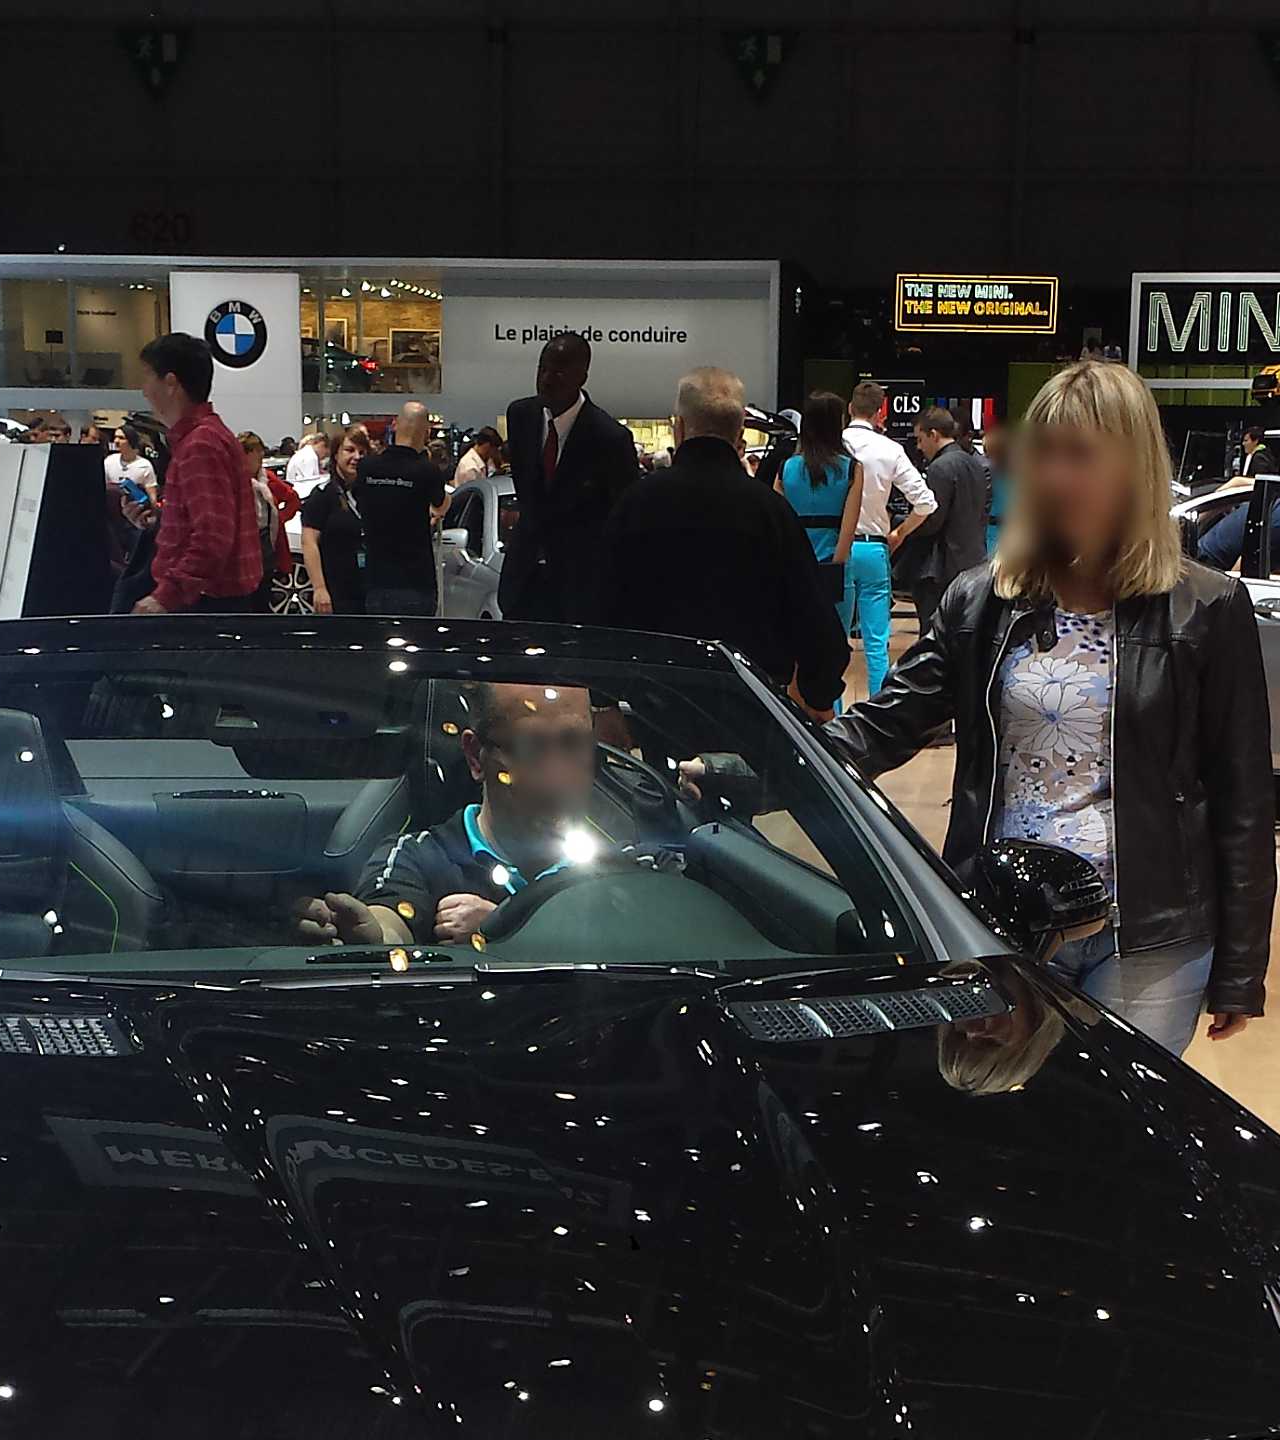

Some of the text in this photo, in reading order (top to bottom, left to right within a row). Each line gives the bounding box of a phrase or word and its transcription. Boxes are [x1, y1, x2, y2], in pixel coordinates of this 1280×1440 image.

[904, 283, 1014, 299] THE NEW MINI.
[209, 301, 262, 324] BMW
[904, 300, 1049, 316] THE NEW ORIGINAL.
[495, 323, 518, 341] Le
[581, 325, 603, 342] de
[608, 326, 688, 344] conduire
[893, 395, 921, 414] CLS
